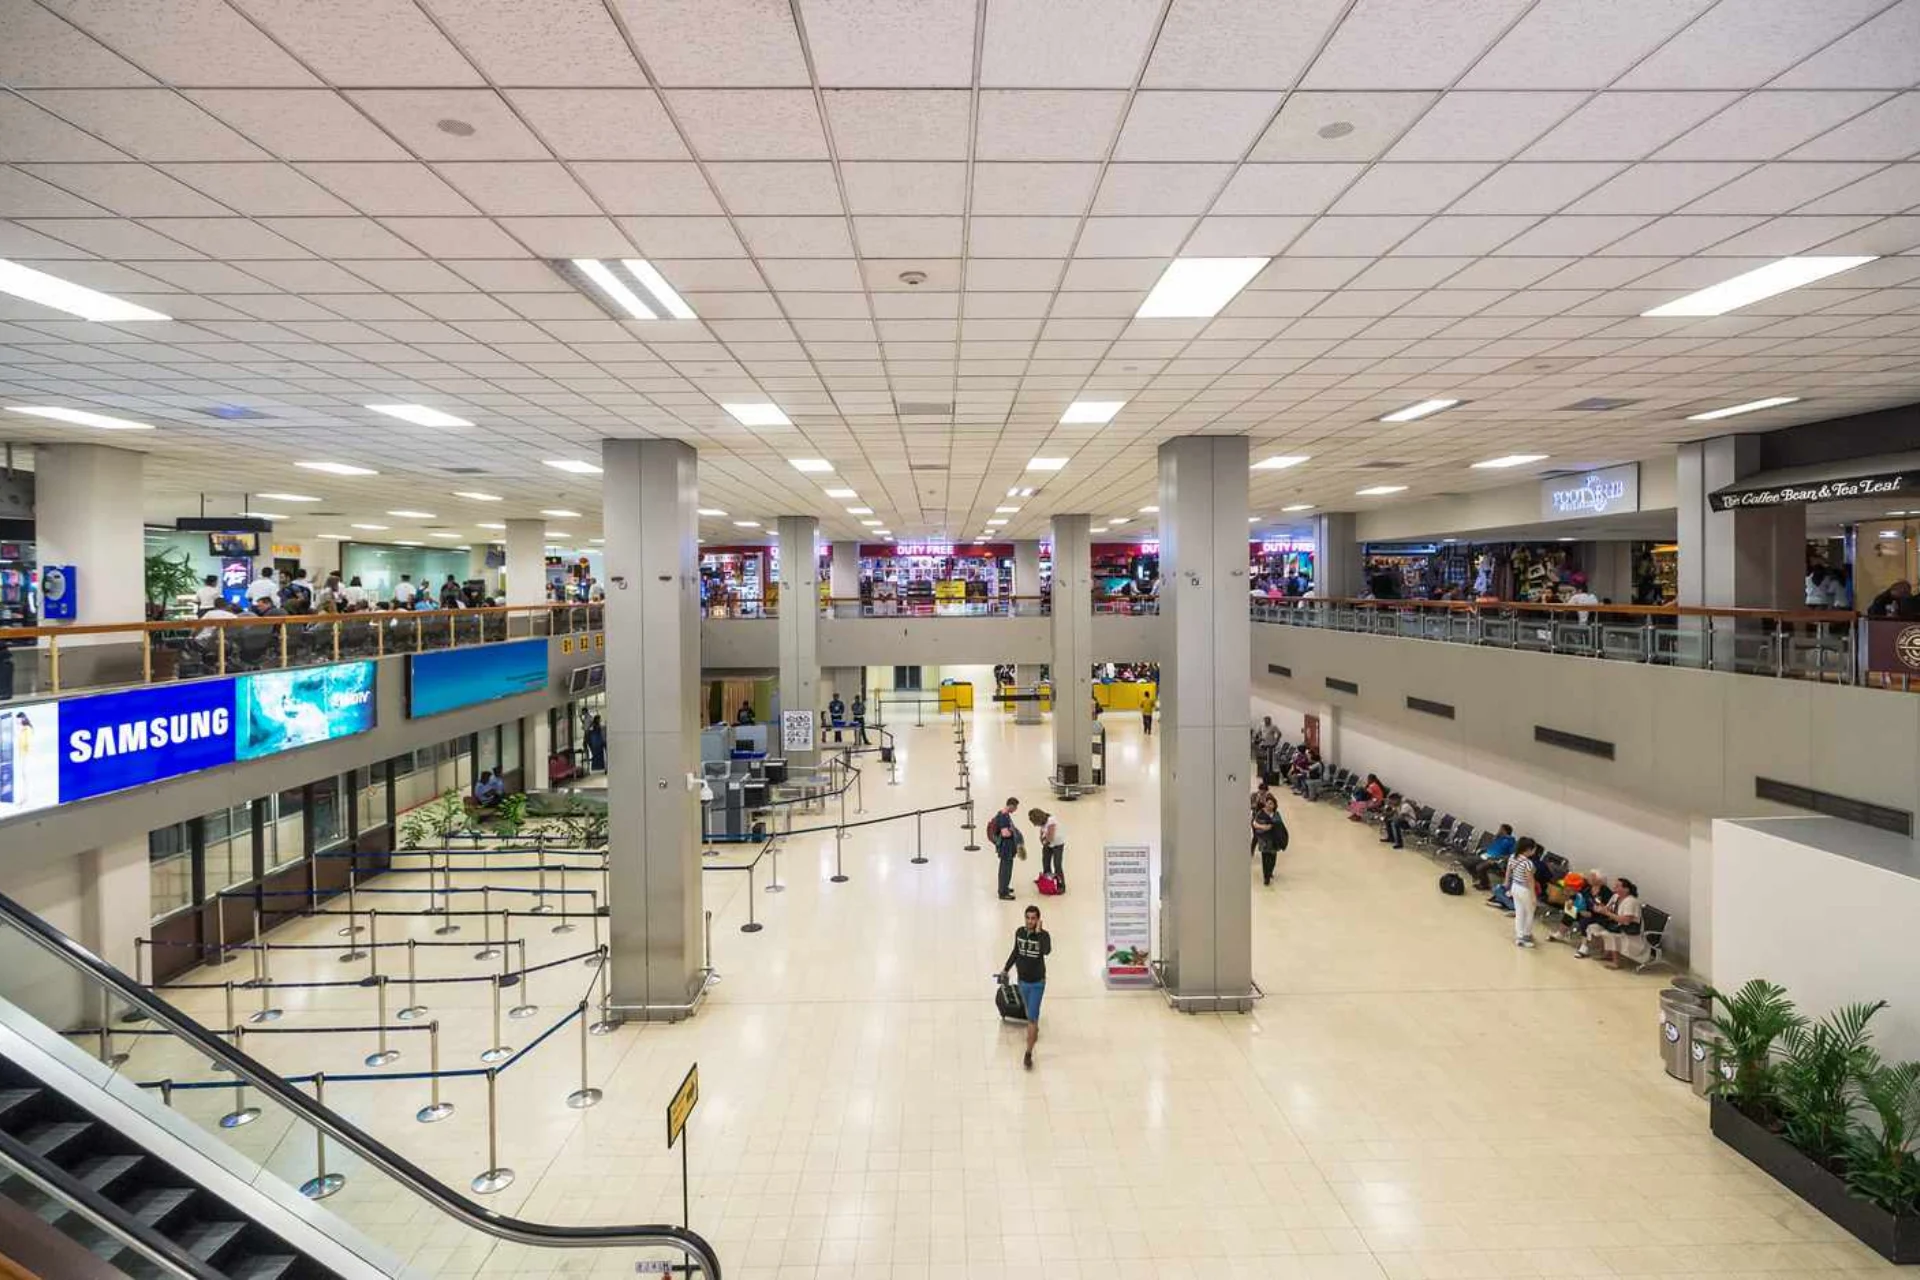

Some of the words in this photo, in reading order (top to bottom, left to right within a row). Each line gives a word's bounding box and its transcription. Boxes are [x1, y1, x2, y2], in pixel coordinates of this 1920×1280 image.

[1741, 492, 1780, 504] Coffee
[1780, 488, 1817, 501] Bean
[1818, 485, 1831, 497] &
[1831, 483, 1858, 496] Tea
[897, 545, 925, 555] DUTY
[926, 545, 953, 555] FREE
[1263, 543, 1290, 552] DUTY
[69, 707, 229, 763] SAMSUNG
